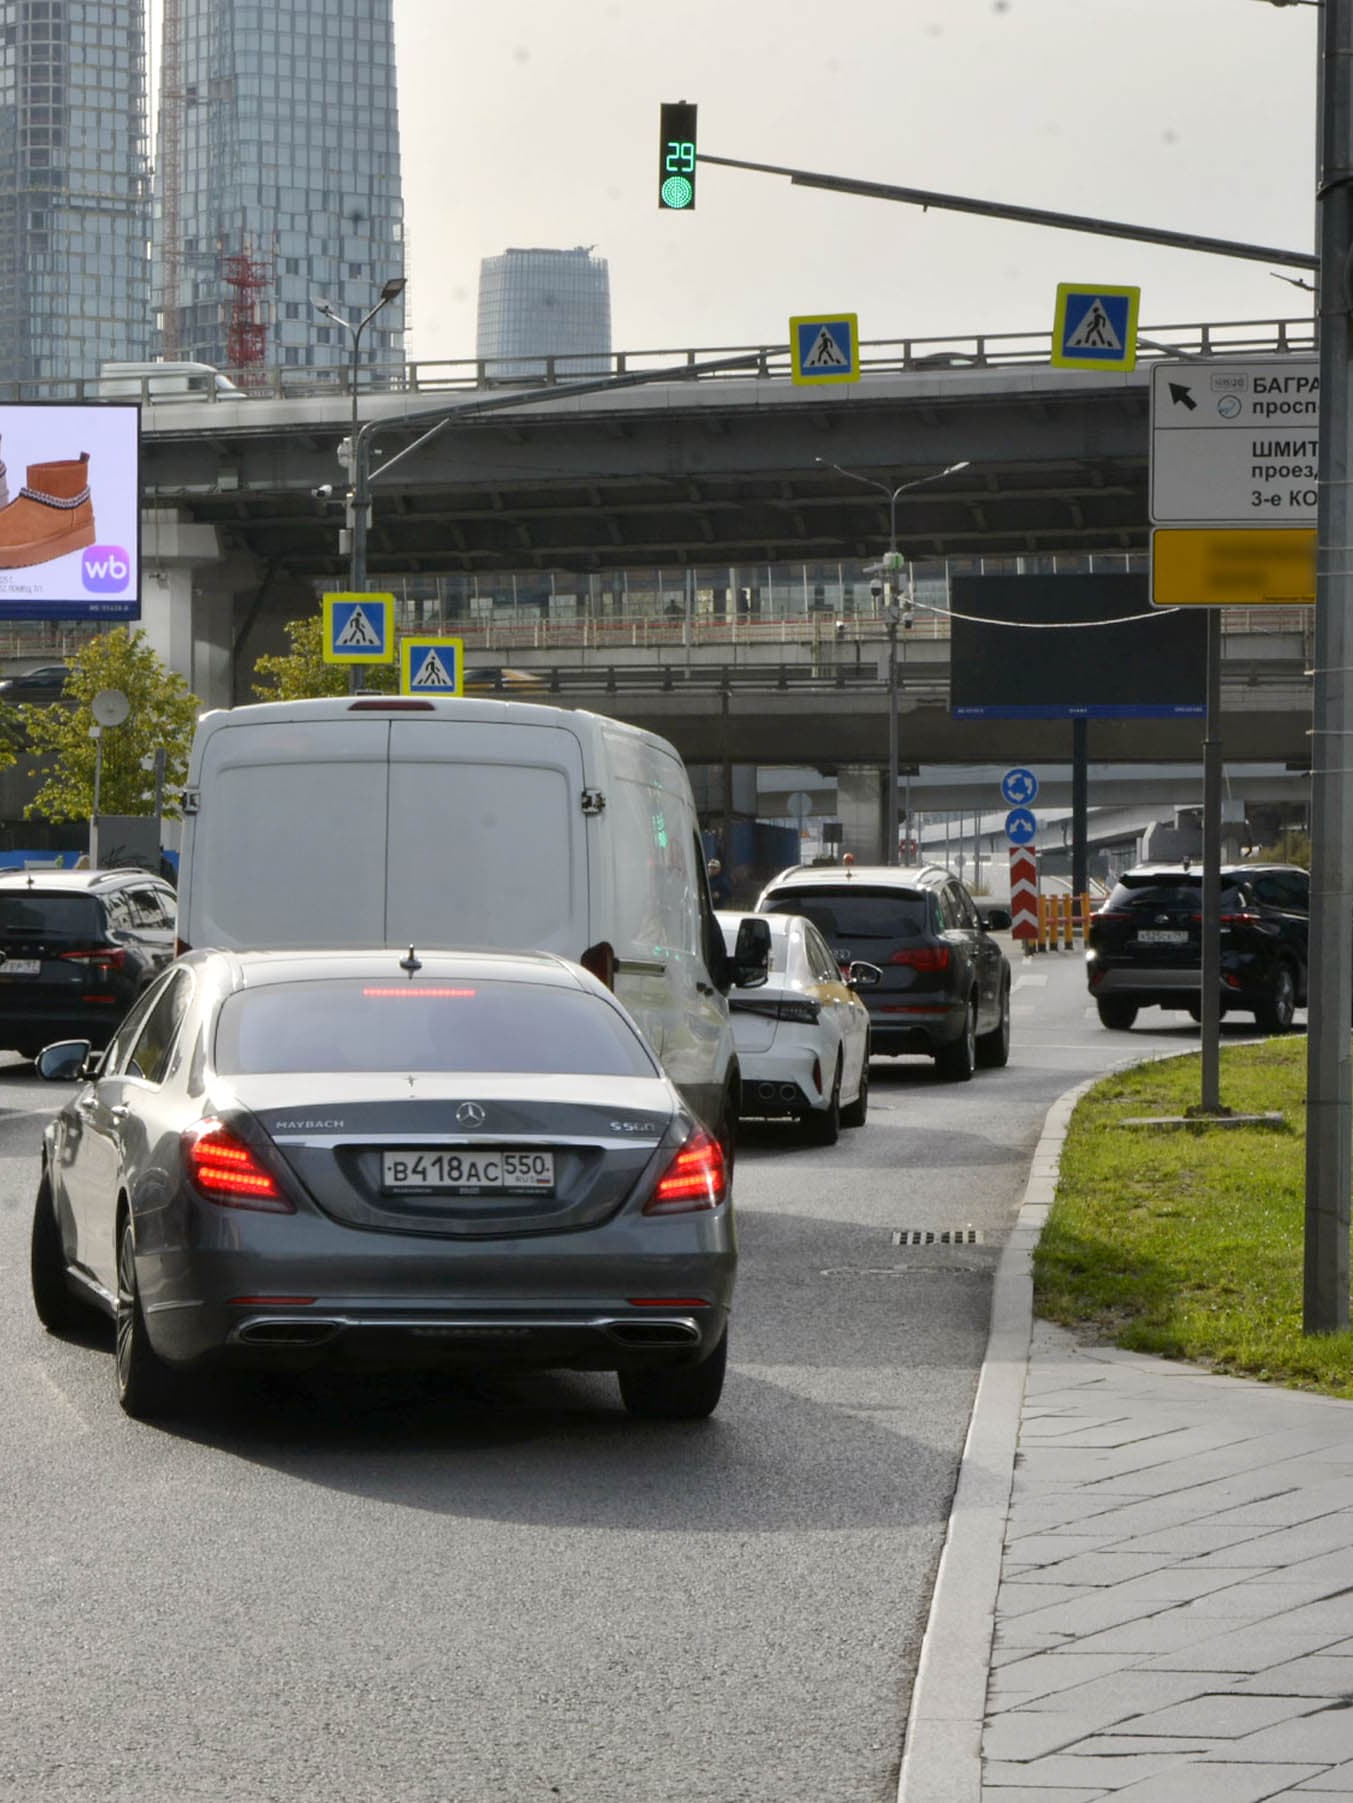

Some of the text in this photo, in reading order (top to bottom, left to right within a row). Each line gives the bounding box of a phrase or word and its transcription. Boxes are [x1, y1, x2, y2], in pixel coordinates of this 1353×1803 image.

[666, 142, 694, 172] 29
[1253, 376, 1320, 394] БАГРА
[1252, 401, 1319, 418] просп
[1252, 440, 1319, 457] ШМИТ
[1251, 465, 1318, 482] проез
[1251, 489, 1318, 506] 3-е КО
[85, 554, 127, 579] wb
[276, 1120, 344, 1129] MAYBACH
